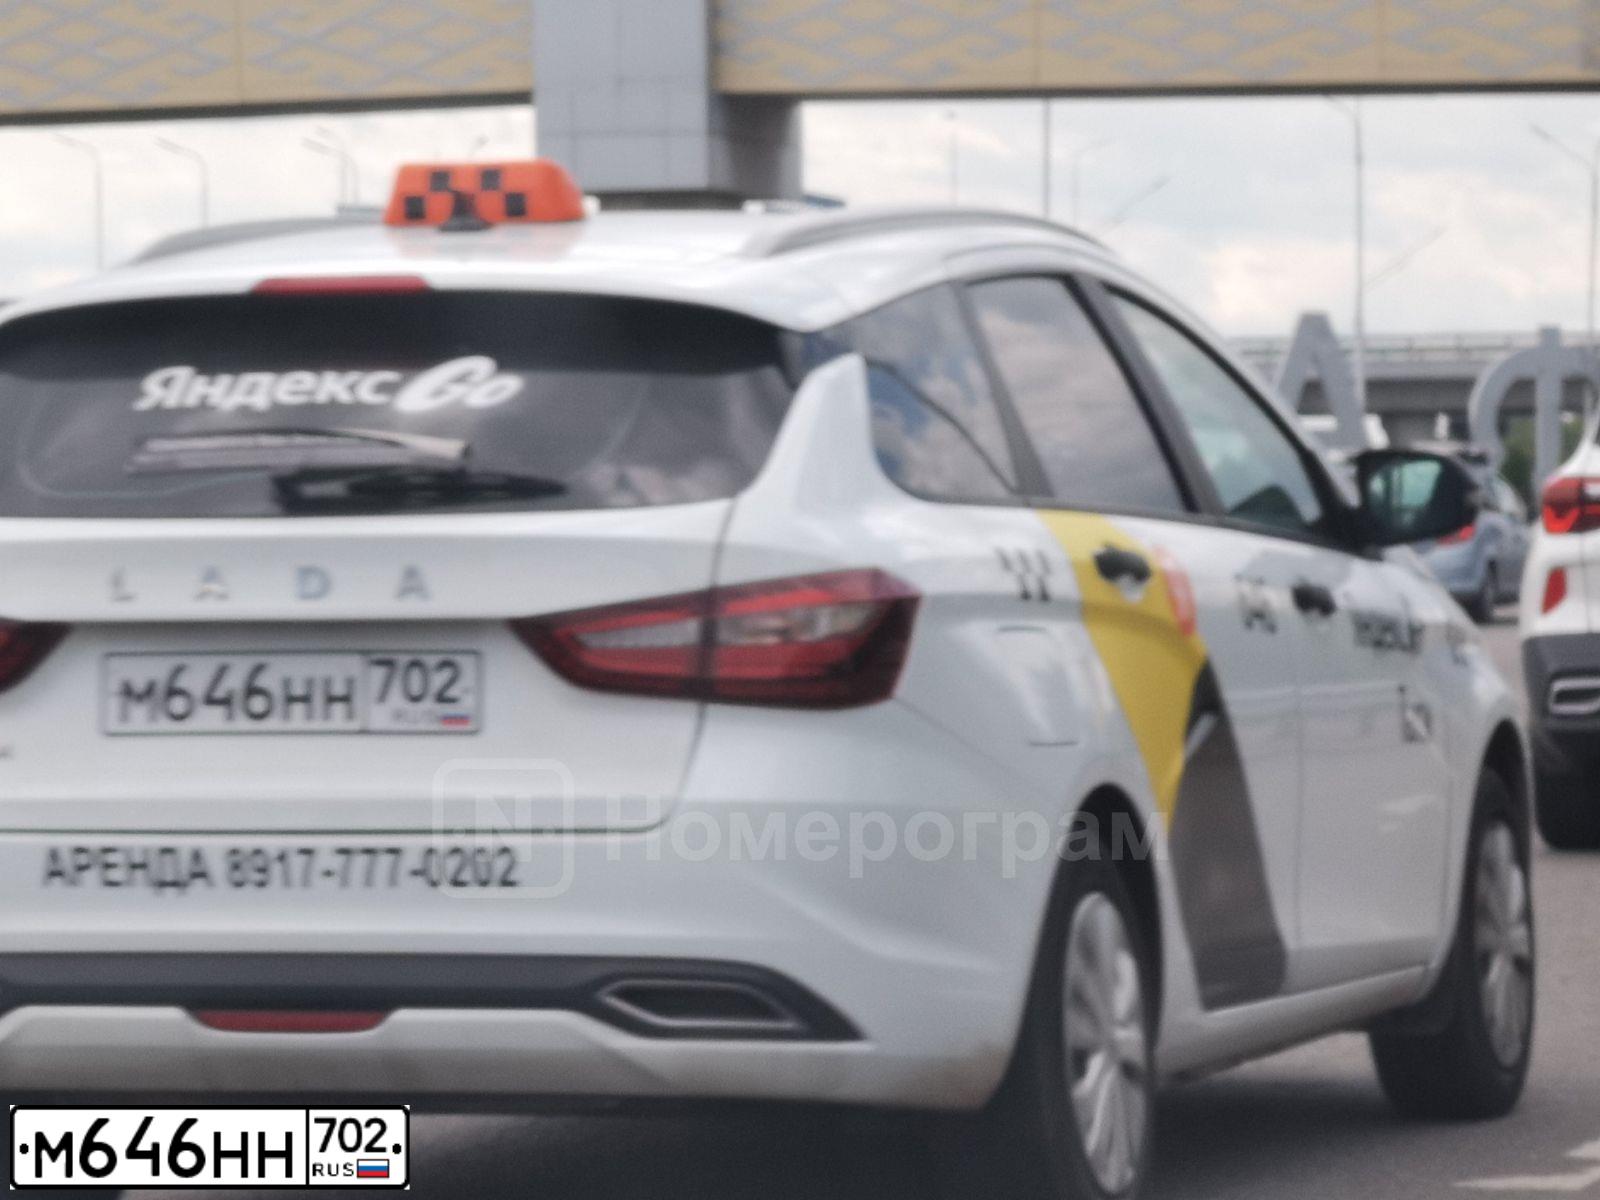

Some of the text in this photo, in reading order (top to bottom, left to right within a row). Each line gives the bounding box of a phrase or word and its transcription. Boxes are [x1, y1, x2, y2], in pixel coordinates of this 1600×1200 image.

[133, 355, 524, 413] Яндекс Go
[109, 564, 432, 601] LADA
[118, 657, 462, 723] М646НН 702
[42, 844, 520, 893] АРЕНДА 8917-777-0202
